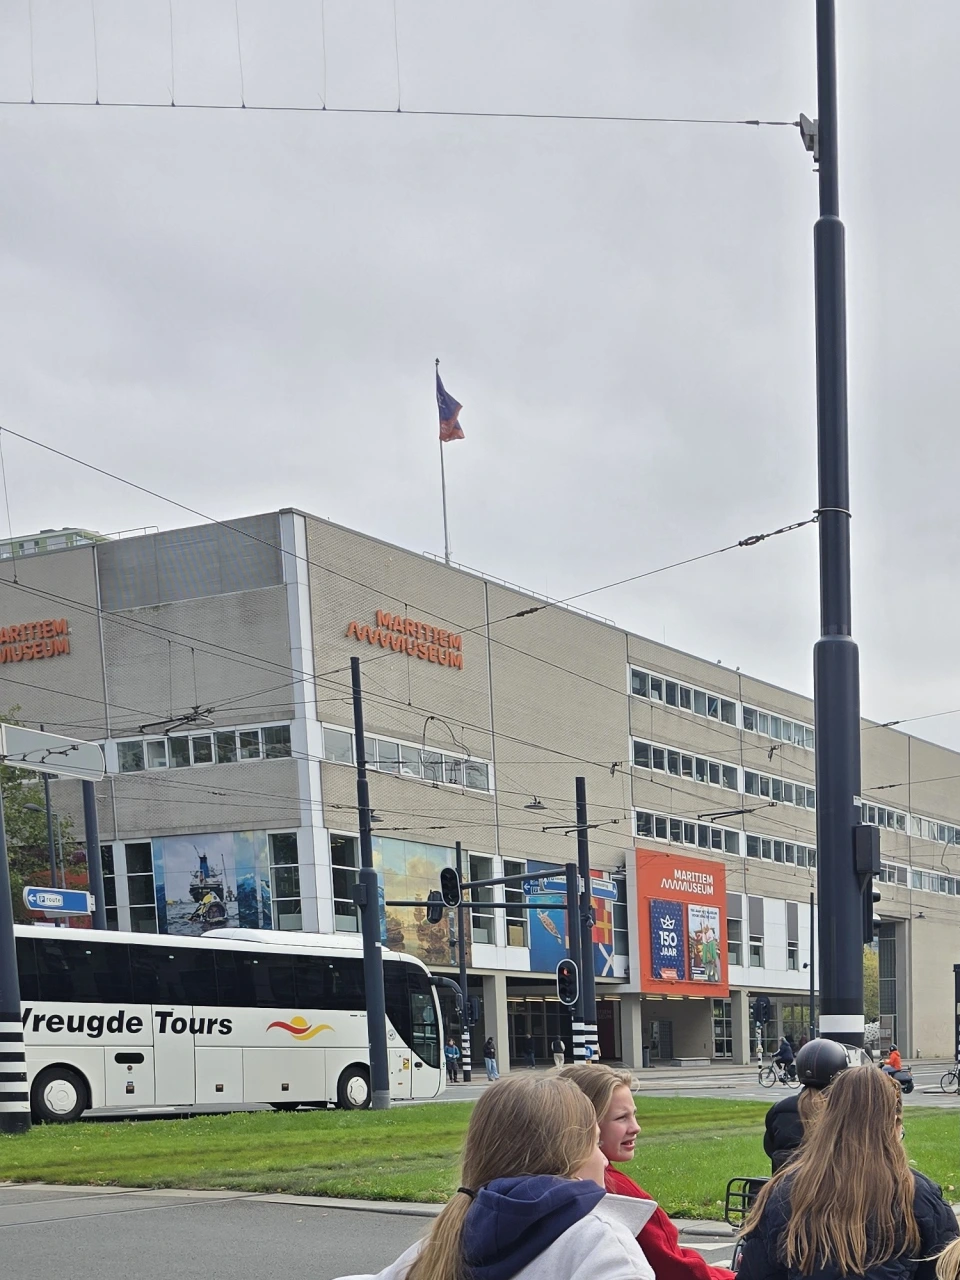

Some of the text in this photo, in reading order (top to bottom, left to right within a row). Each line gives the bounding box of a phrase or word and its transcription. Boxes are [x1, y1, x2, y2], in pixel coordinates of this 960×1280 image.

[0, 618, 68, 645] ARITIEM
[376, 609, 463, 652] MARITIEM
[674, 869, 714, 885] MARITIEM
[659, 931, 677, 946] 150
[660, 947, 677, 957] JAAR
[23, 1008, 233, 1038] Vreugde Tours
